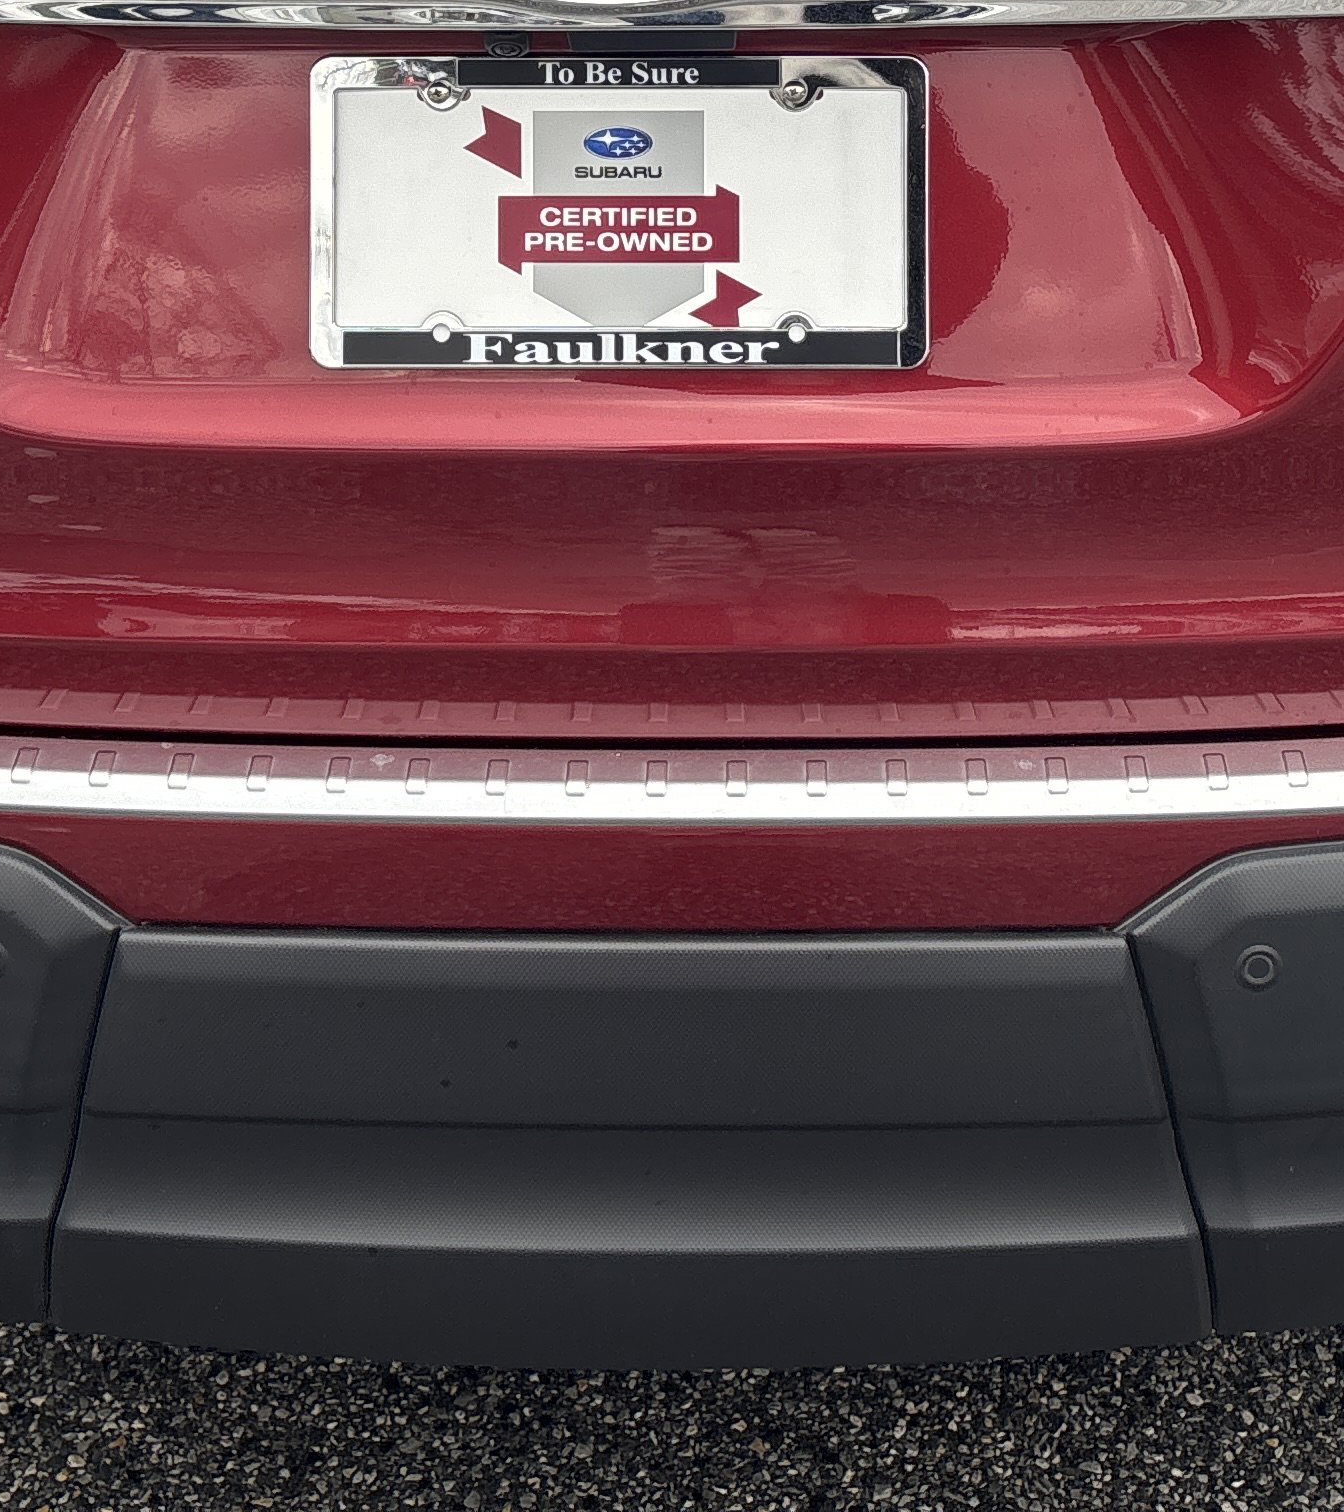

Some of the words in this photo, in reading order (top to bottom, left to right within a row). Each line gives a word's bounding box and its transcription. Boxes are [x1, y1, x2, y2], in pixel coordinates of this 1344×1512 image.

[538, 62, 578, 85] To
[584, 62, 622, 85] Be
[630, 62, 701, 85] Sure
[574, 166, 663, 179] SUBARU
[539, 206, 698, 227] CERTIFIED
[524, 231, 713, 252] PRE-OWNED
[462, 332, 780, 365] Faulkner
